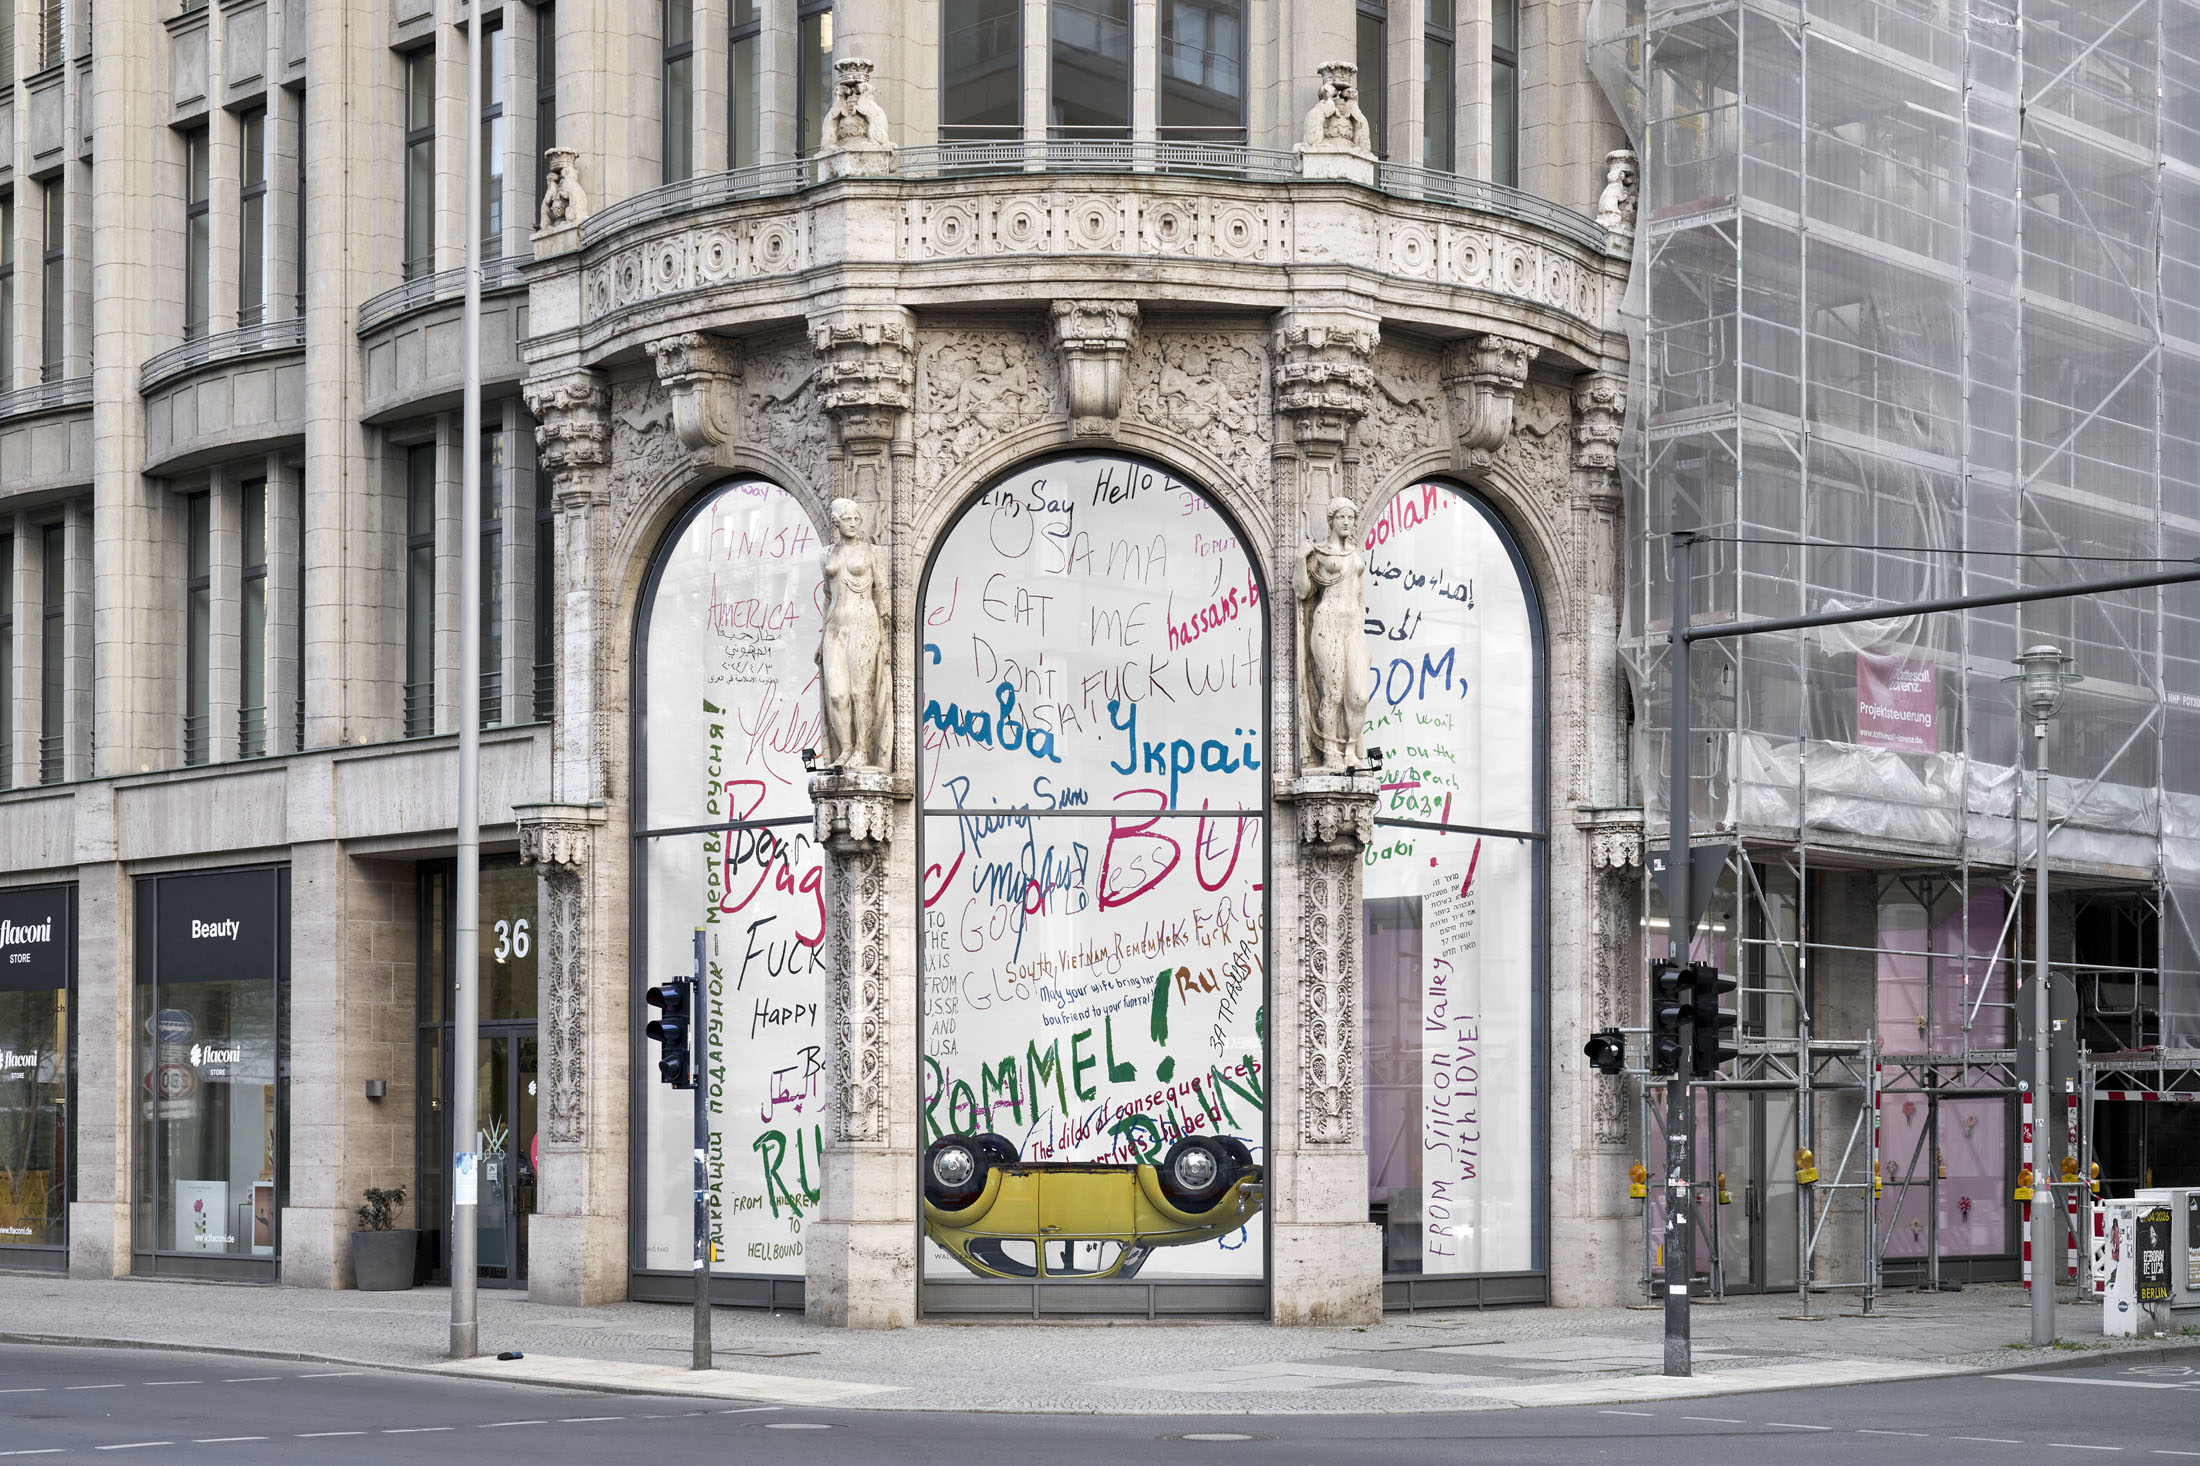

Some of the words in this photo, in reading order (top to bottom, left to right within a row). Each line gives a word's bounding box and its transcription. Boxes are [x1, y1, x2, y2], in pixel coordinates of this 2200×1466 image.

[1026, 479, 1075, 538] Say
[1092, 463, 1153, 506] Hello
[1091, 601, 1151, 647] ME
[1860, 701, 1932, 728] Projektsteuerung
[0, 916, 51, 949] flaconi
[191, 918, 240, 940] Beauty
[493, 918, 530, 959] 36
[9, 953, 31, 964] STORE
[1424, 957, 1455, 1032] Valley
[5, 1050, 38, 1070] flaconi
[203, 1045, 241, 1066] flaconi
[210, 1068, 226, 1077] STORE
[1428, 1180, 1456, 1257] FROM
[2141, 1287, 2168, 1300] BERLIN
